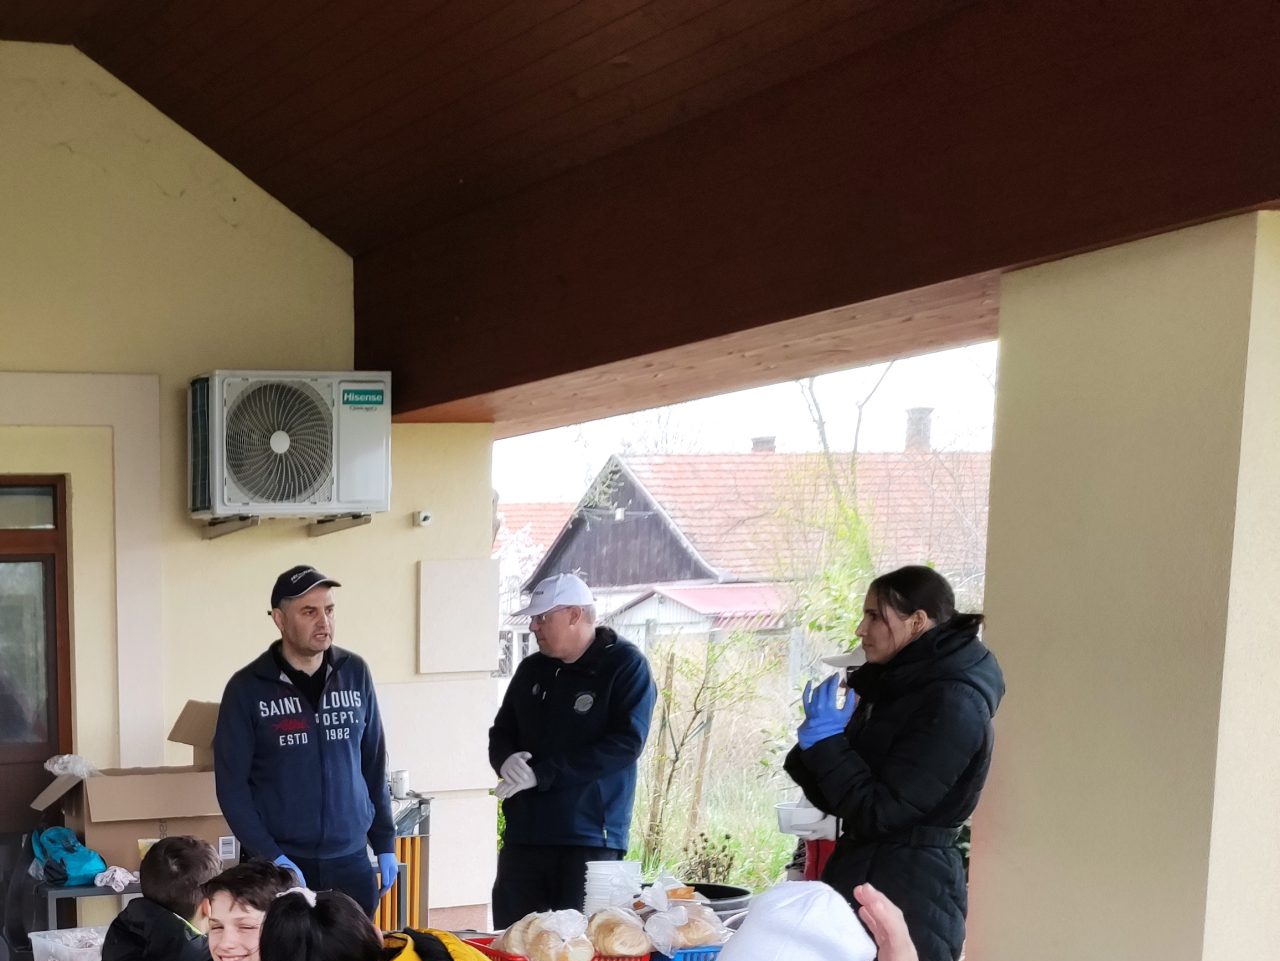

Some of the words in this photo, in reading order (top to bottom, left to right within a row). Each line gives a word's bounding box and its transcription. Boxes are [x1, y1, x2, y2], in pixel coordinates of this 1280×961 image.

[344, 392, 383, 401] Hisense
[259, 696, 303, 717] SAINT
[322, 690, 362, 709] LOUIS
[322, 711, 359, 726] DEPT.
[279, 732, 309, 746] ESTD
[325, 727, 350, 741] 1982
